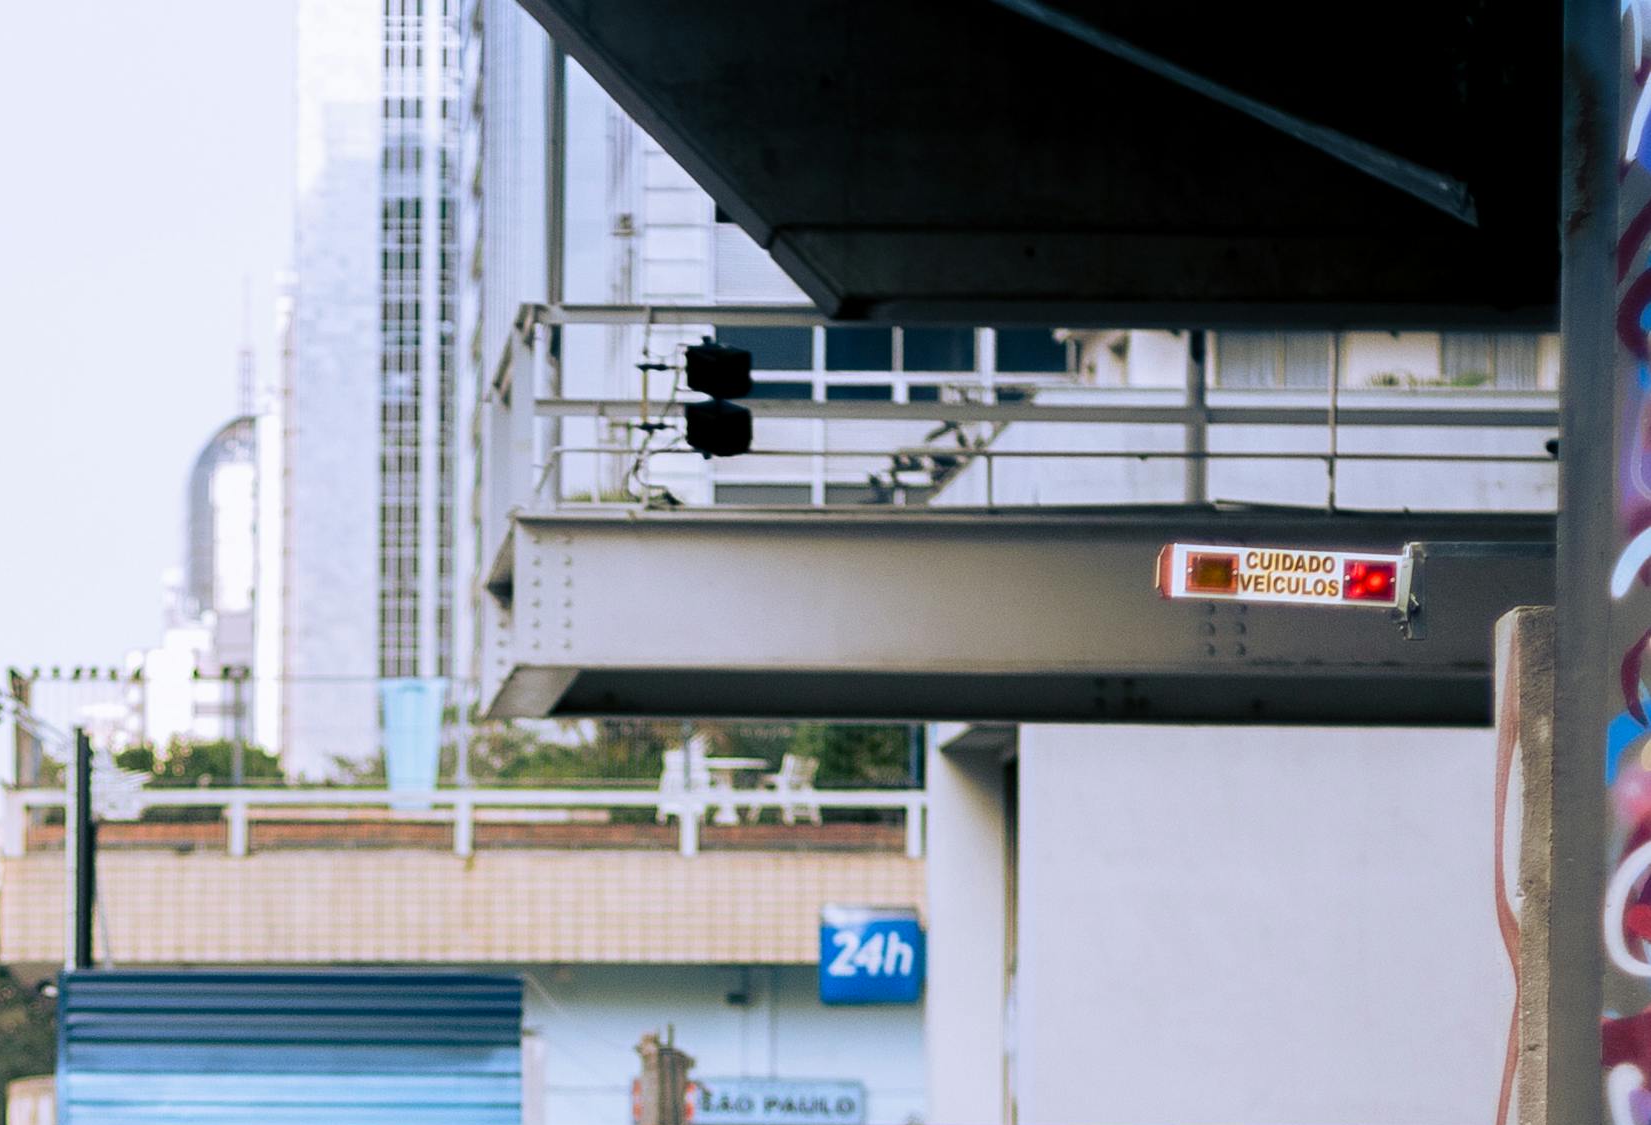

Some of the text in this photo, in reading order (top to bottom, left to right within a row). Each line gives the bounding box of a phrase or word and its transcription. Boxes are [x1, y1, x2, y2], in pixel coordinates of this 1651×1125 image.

[1246, 551, 1336, 574] CUIDADO
[1239, 570, 1340, 597] VEÍCULOS
[828, 931, 914, 977] 24h
[763, 1095, 856, 1116] PAULO
